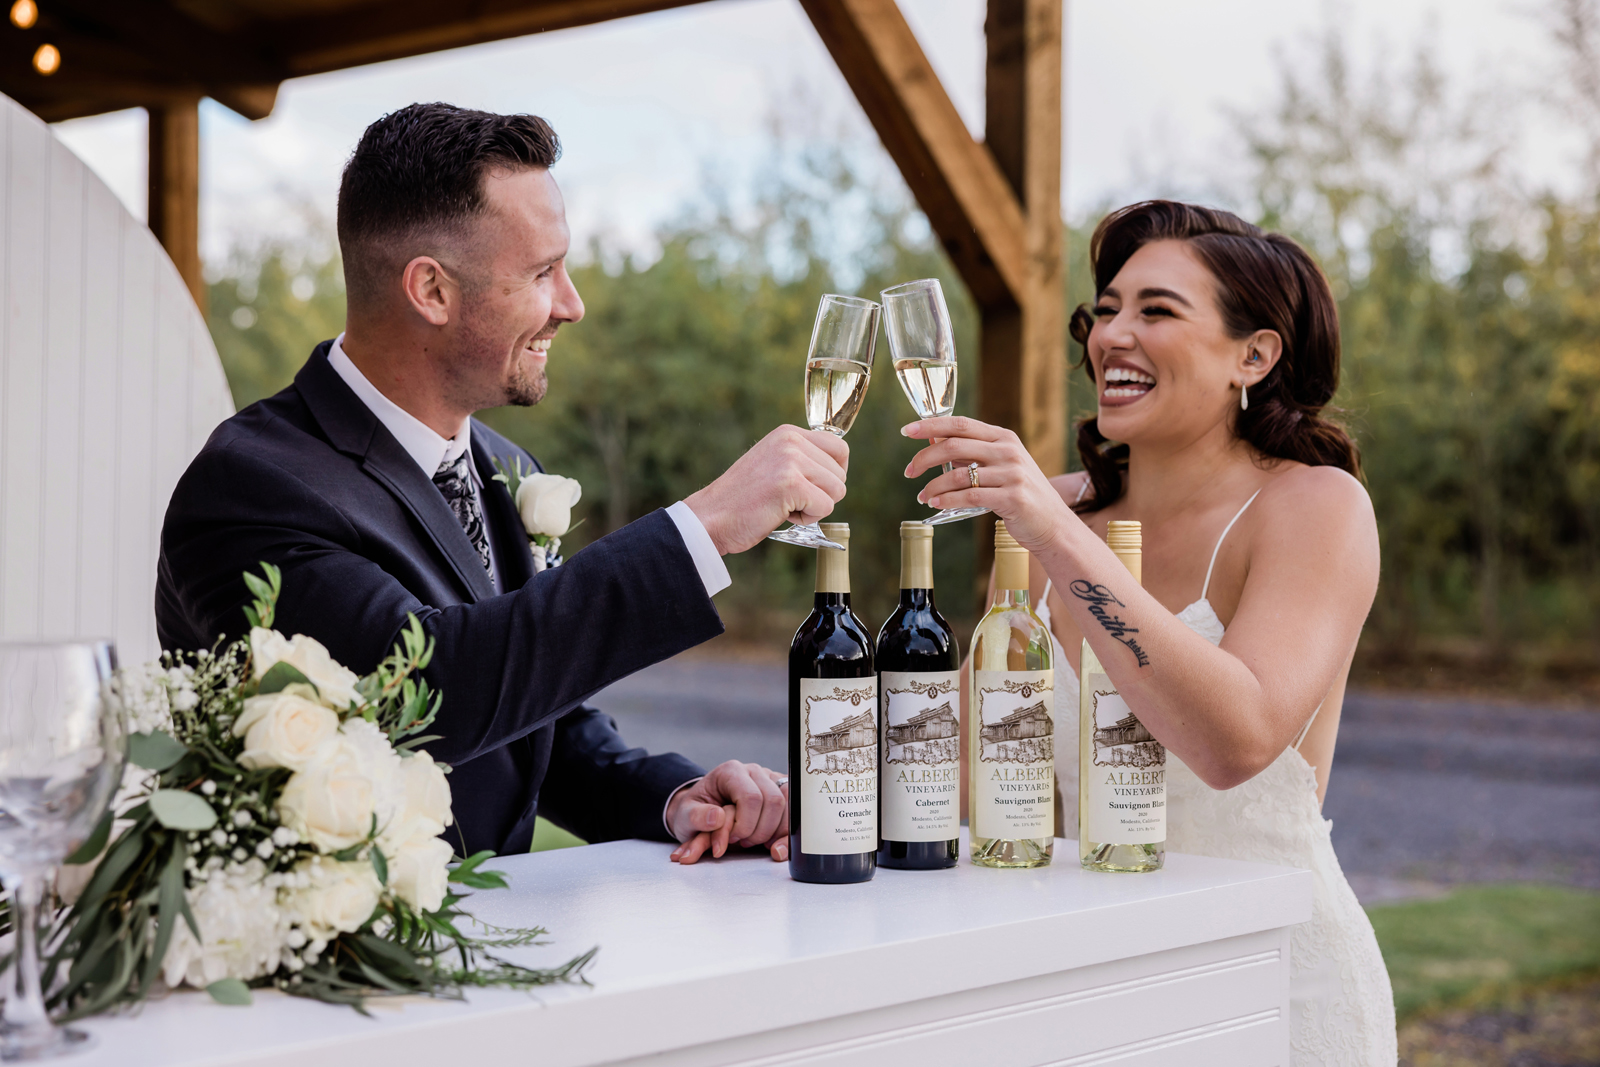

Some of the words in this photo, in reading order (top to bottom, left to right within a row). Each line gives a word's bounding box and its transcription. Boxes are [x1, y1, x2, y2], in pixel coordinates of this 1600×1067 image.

[1070, 580, 1139, 637] Faith
[905, 784, 956, 793] VINEYARDS
[999, 782, 1049, 792] VINEYARDS
[1114, 786, 1163, 796] VINEYARDS
[828, 793, 876, 804] VINEYARDS
[994, 797, 1036, 806] Sauvignon
[1108, 802, 1150, 810] Sauvignon
[838, 809, 872, 818] Grenache
